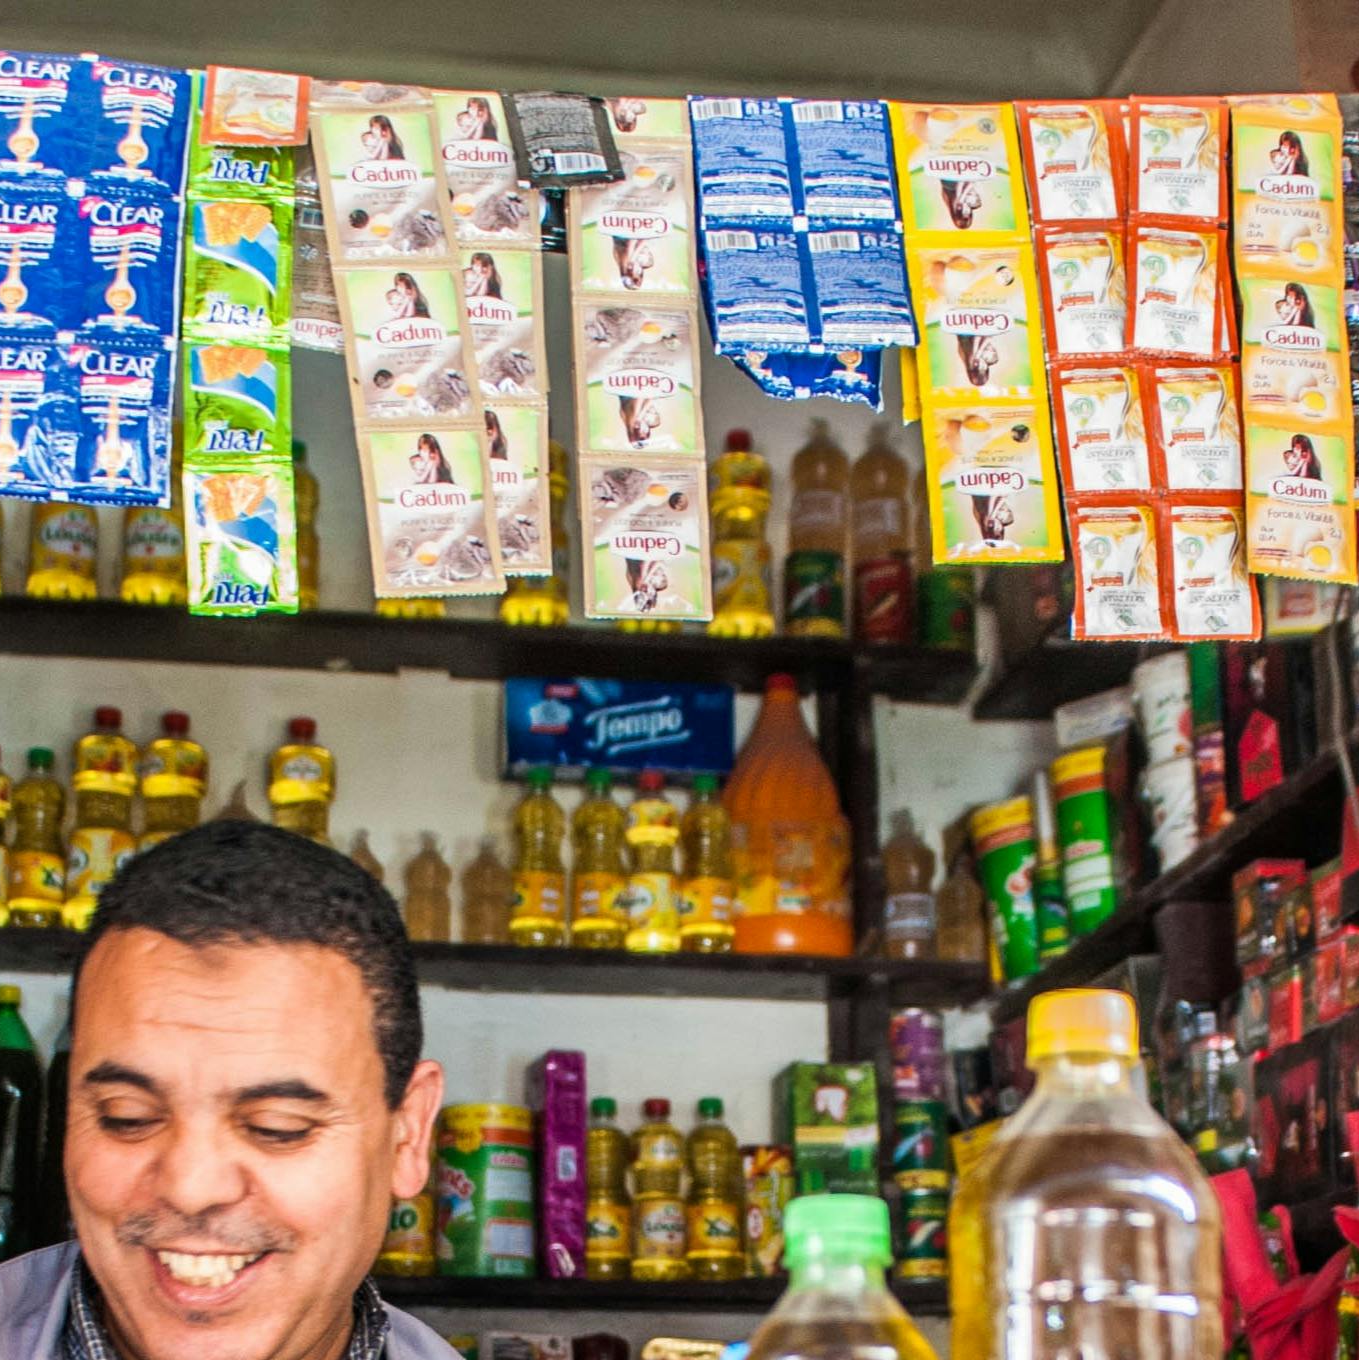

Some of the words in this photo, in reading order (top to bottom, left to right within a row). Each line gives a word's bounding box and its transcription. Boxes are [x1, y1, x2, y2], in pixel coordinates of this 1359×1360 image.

[103, 67, 178, 96] CLEAR
[442, 144, 508, 164] Cadum
[352, 165, 417, 183] Cadum
[929, 159, 992, 178] Cadum
[1260, 178, 1314, 197] Cadum
[92, 201, 164, 227] CLEAR
[602, 214, 670, 233] Cadum
[467, 303, 512, 321] dum
[945, 313, 1009, 330] Cadum
[295, 320, 343, 338] adum
[377, 325, 442, 345] Cadum
[1266, 331, 1320, 350] Cadum
[81, 350, 157, 378] CLEAR
[609, 375, 675, 393] Cadum
[961, 470, 1025, 489] Cadum
[400, 489, 466, 509] Cadum
[1272, 479, 1327, 500] Cadum
[615, 534, 681, 554] Cadum
[585, 696, 685, 750] Tempo
